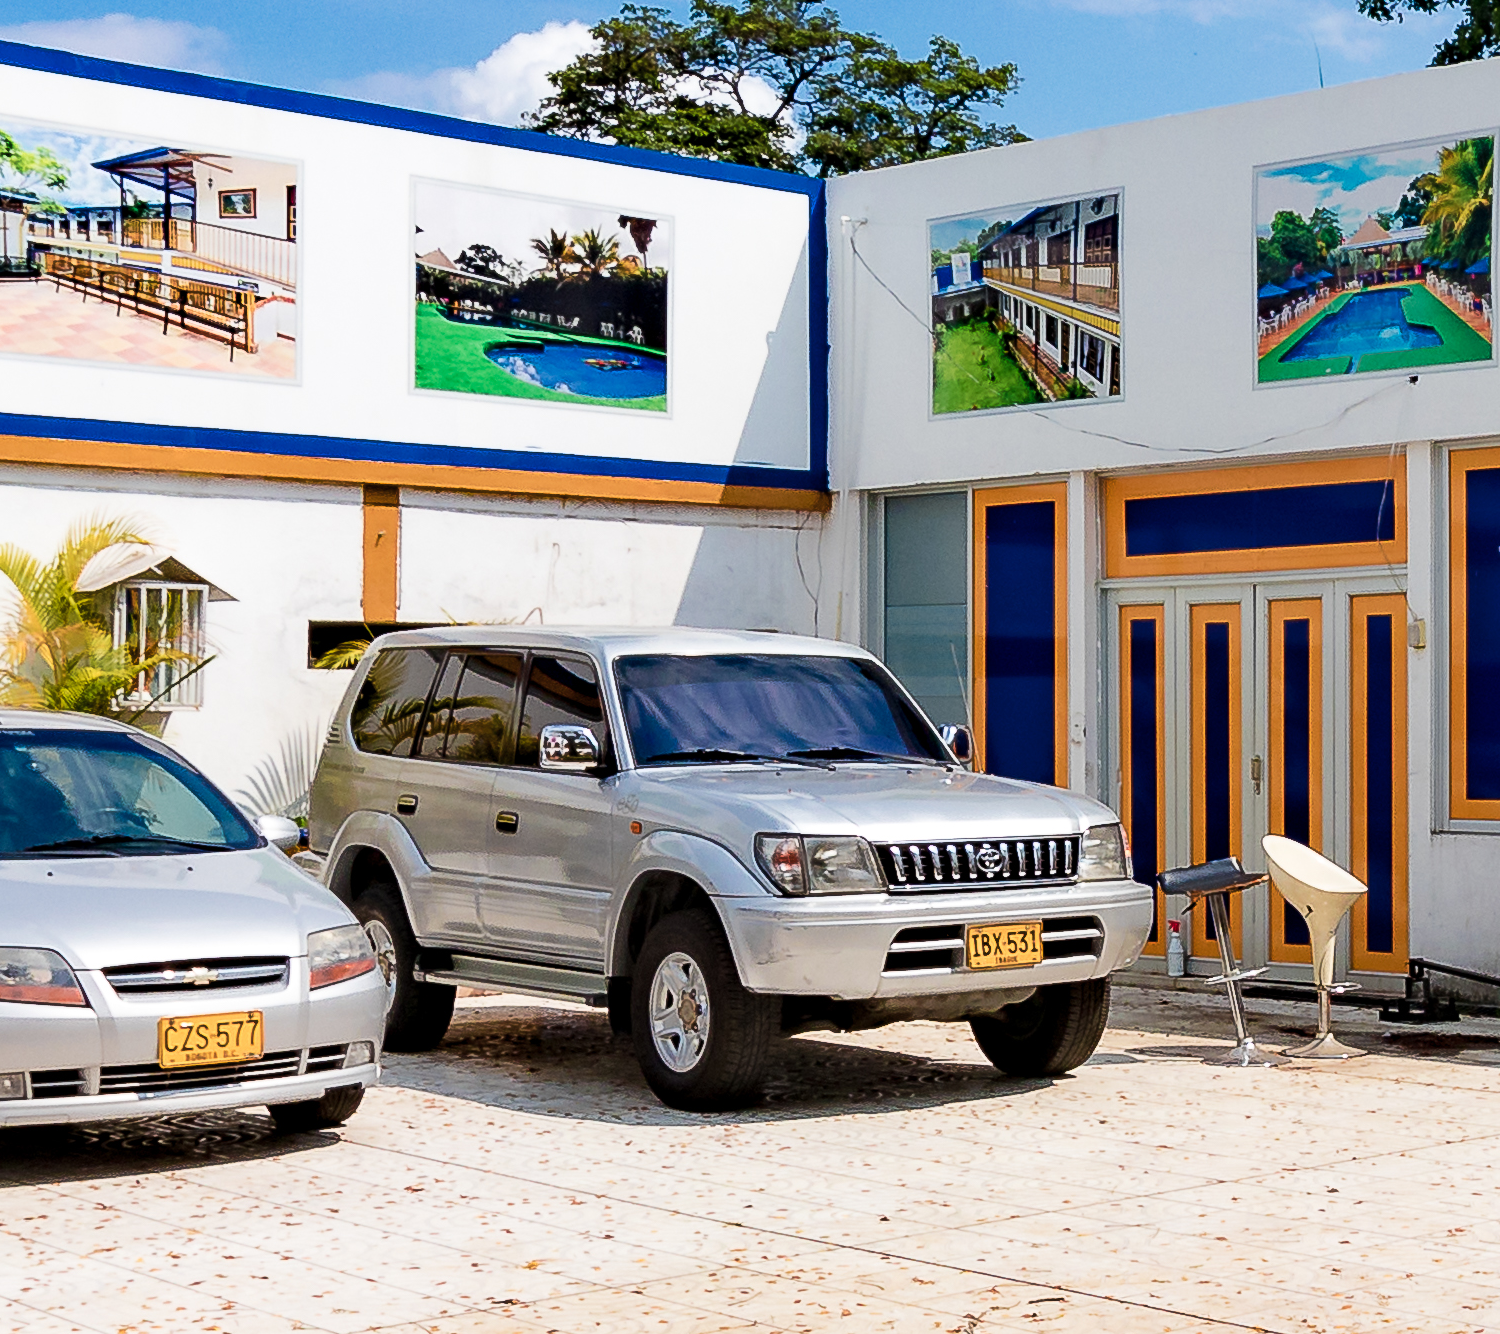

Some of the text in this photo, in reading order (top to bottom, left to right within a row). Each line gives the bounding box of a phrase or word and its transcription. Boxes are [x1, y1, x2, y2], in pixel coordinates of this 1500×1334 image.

[972, 930, 1038, 957] IBX 531
[164, 1019, 259, 1052] CZS 577
